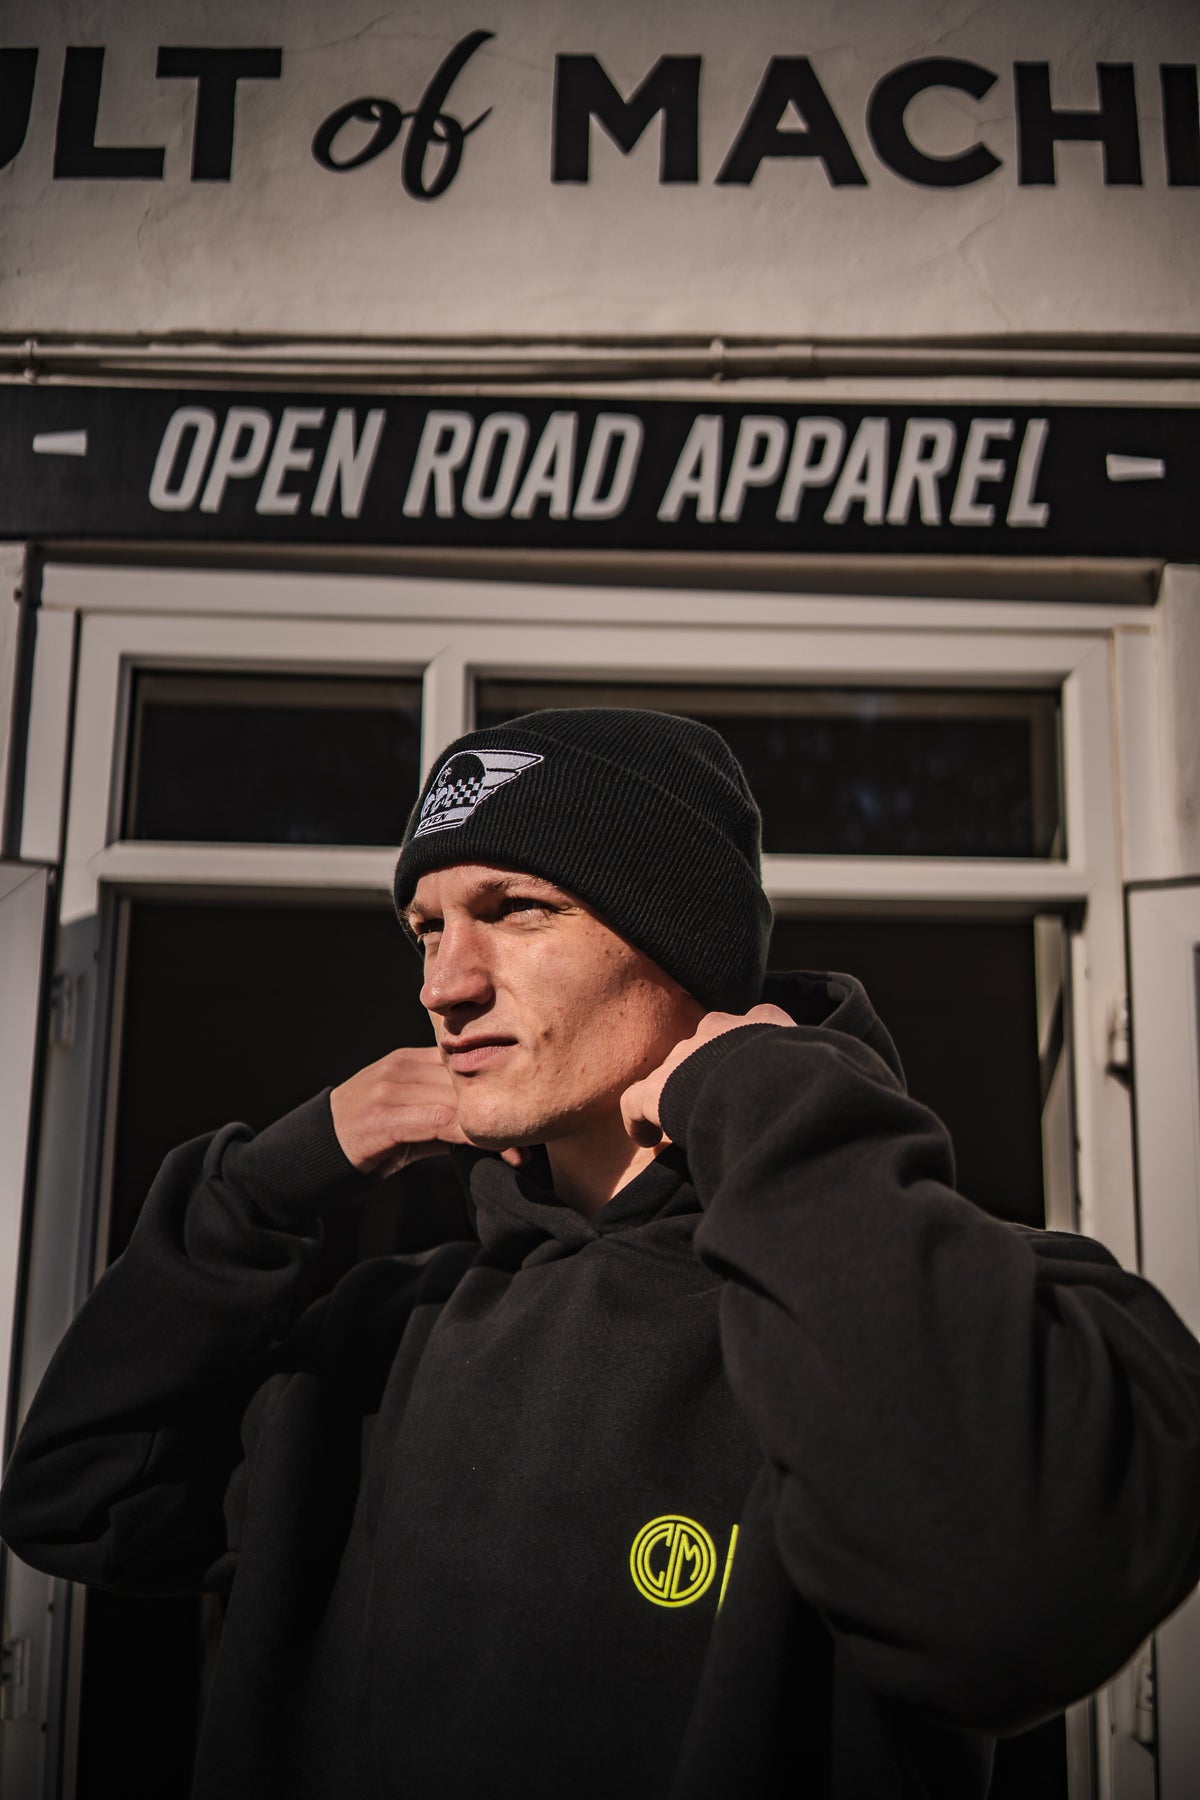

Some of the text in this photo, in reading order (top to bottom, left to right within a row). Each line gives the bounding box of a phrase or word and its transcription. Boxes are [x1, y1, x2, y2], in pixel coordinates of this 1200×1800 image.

[312, 29, 496, 200] of
[148, 405, 1050, 528] OPEN ROAD APPAREL
